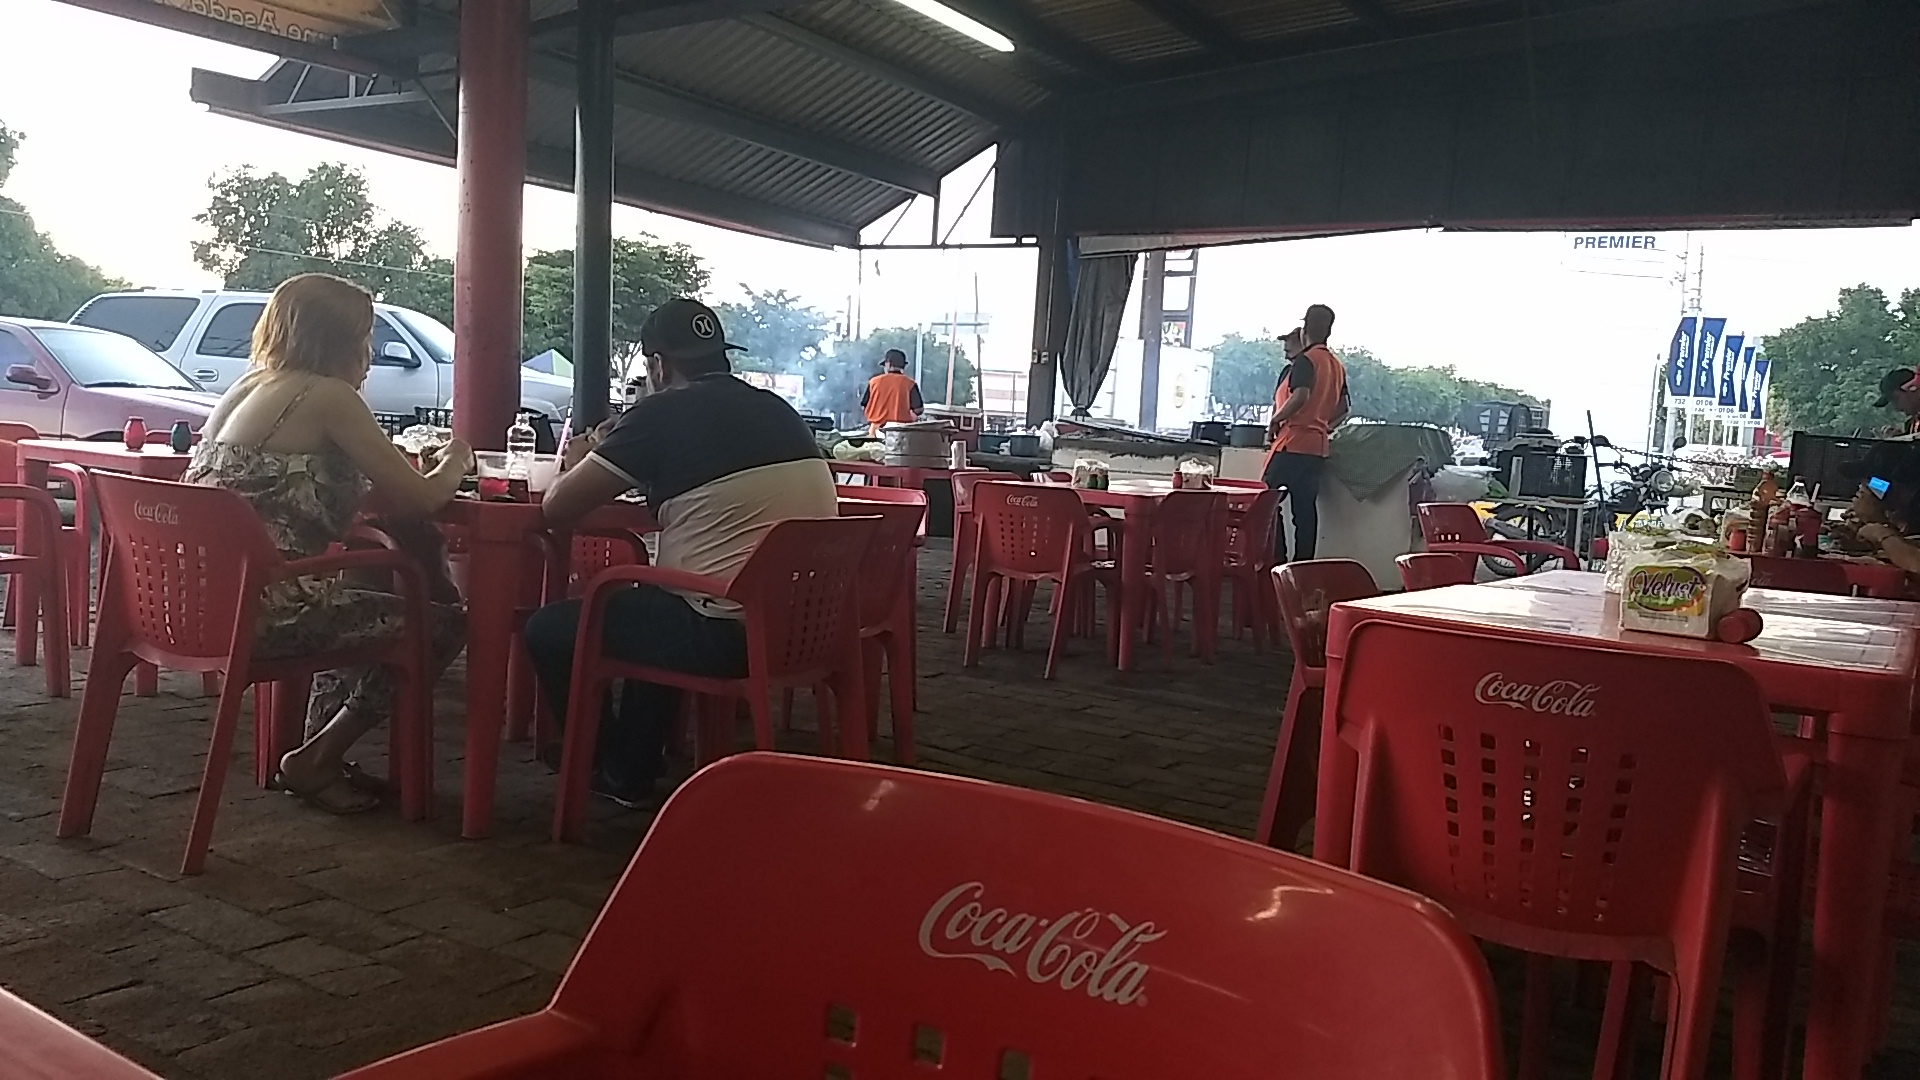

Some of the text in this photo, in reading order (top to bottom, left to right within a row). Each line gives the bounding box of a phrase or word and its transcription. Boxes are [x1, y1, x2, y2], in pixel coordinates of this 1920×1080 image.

[1574, 235, 1656, 250] PREMIER
[134, 499, 178, 525] CocaCola
[1006, 494, 1038, 507] CocaCola
[1475, 672, 1600, 717] Coca-Cola
[918, 881, 1167, 1005] Coca-Cola
